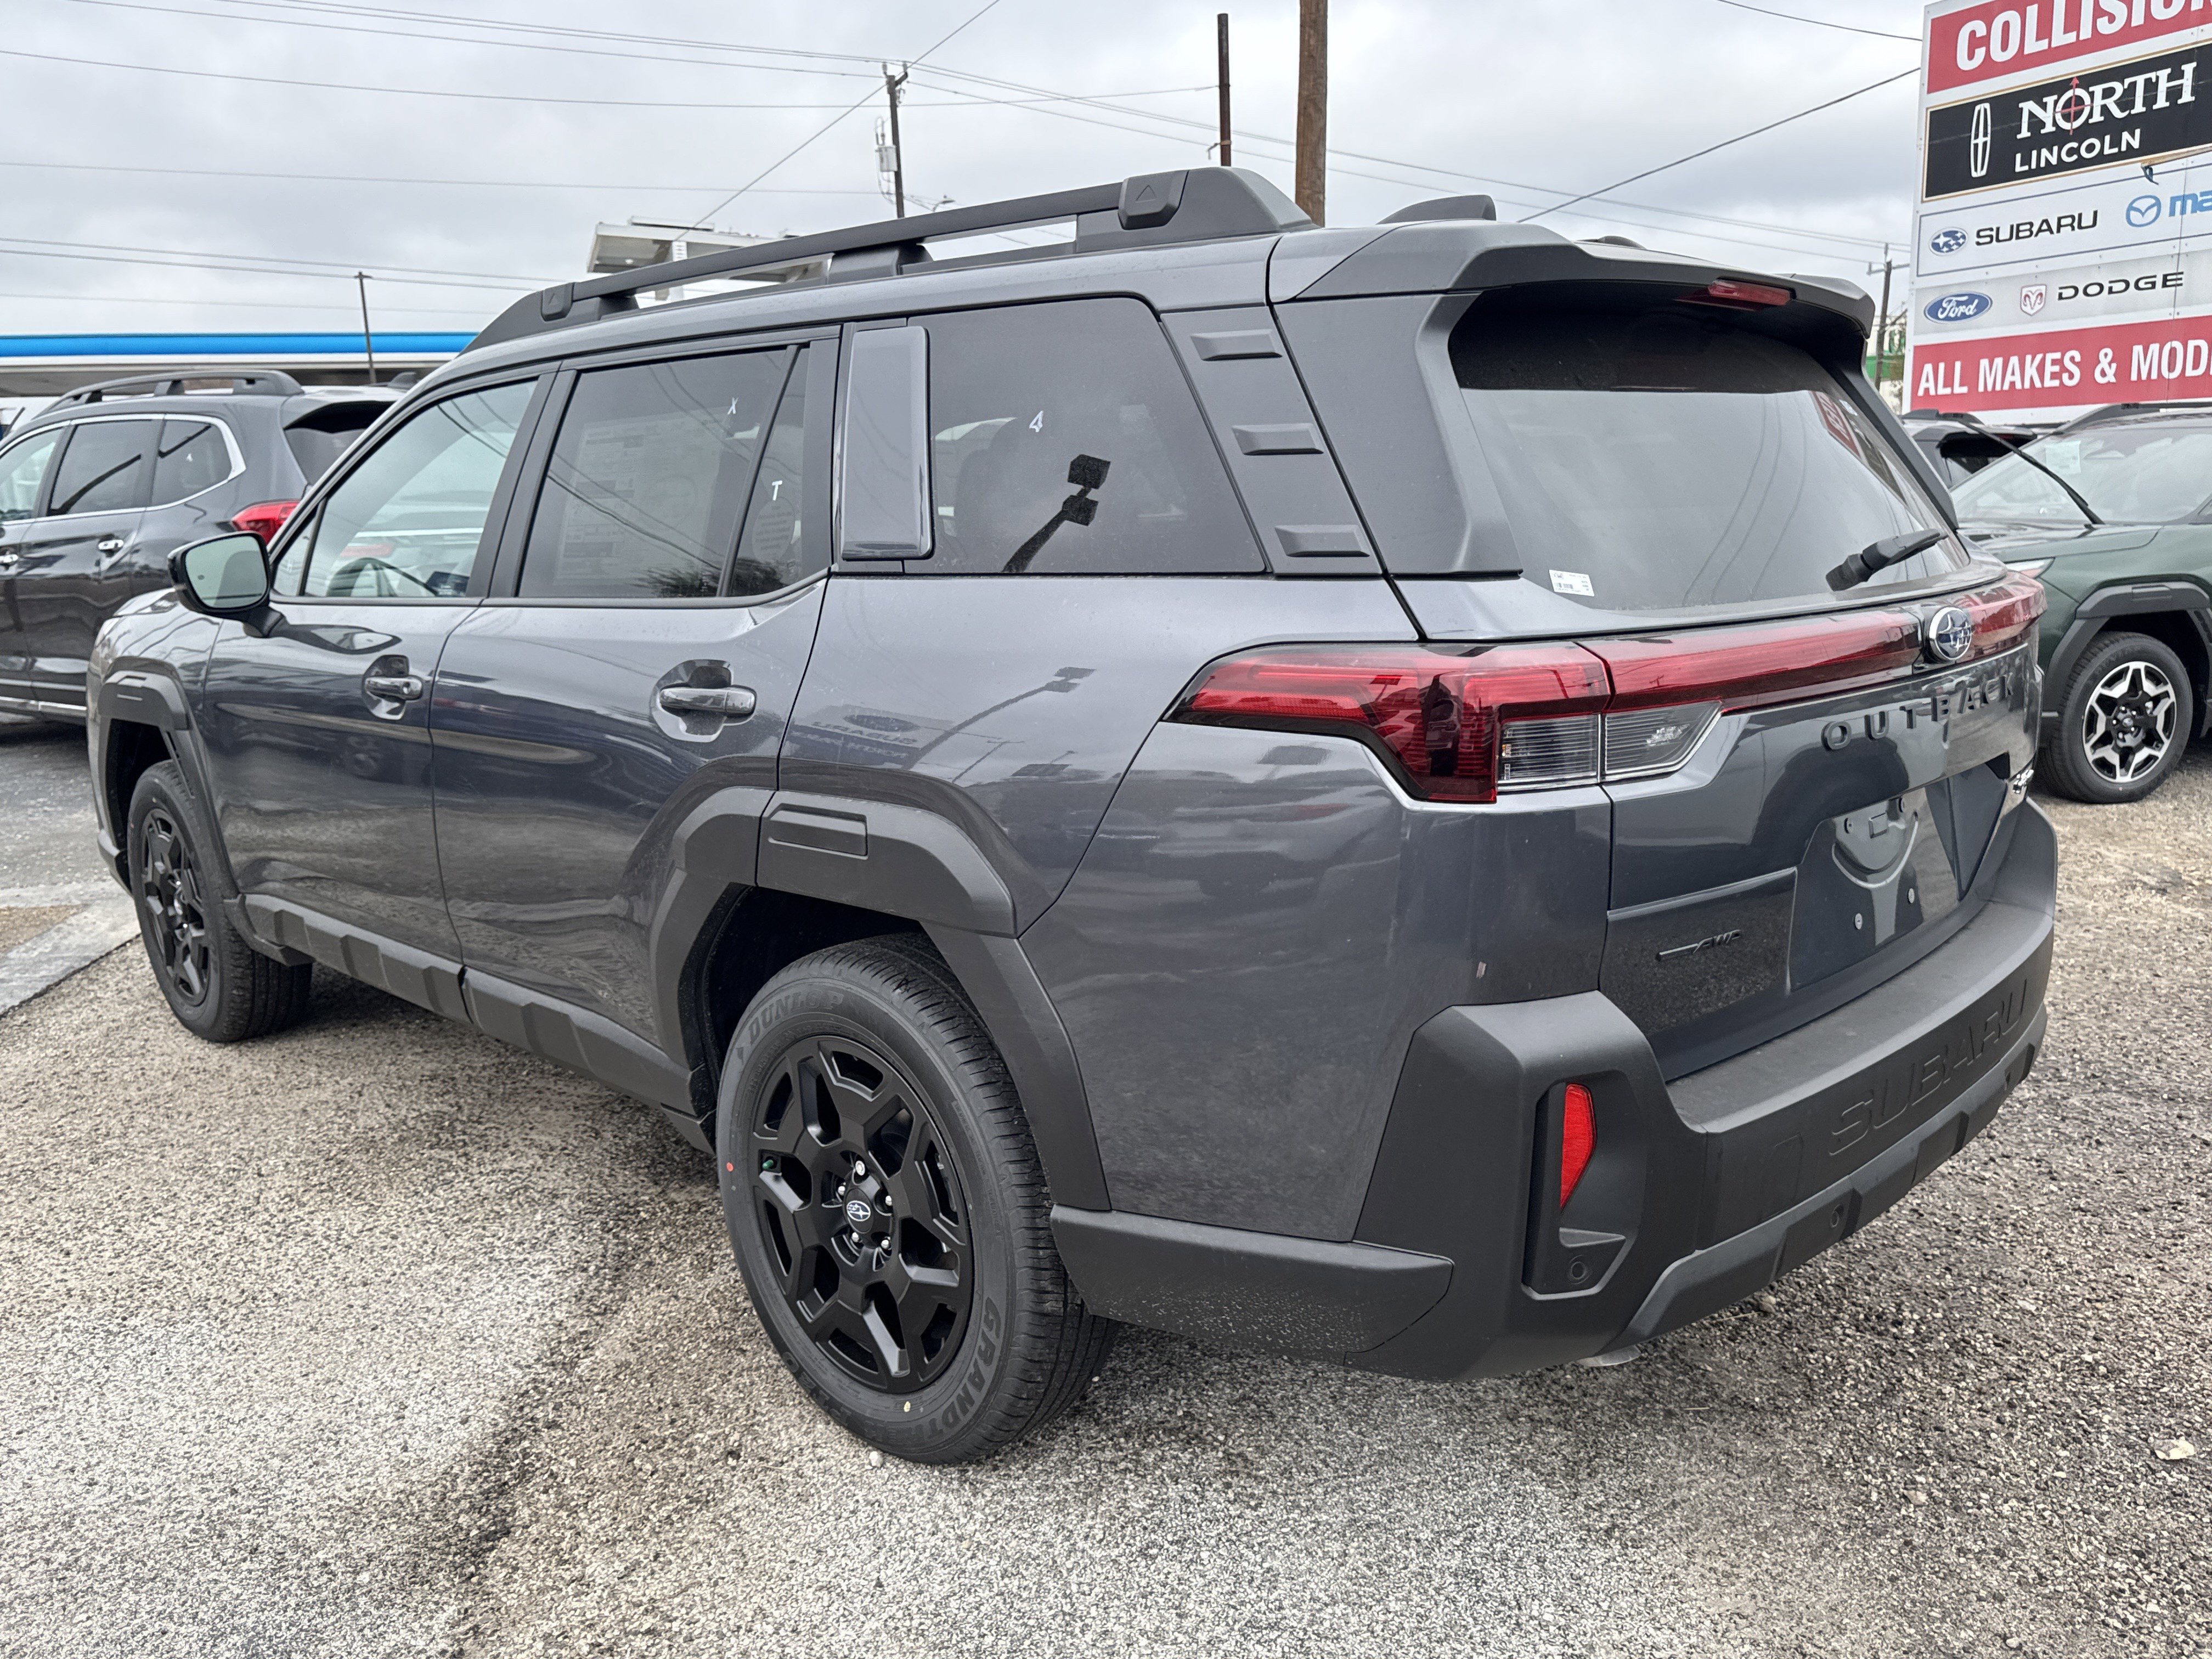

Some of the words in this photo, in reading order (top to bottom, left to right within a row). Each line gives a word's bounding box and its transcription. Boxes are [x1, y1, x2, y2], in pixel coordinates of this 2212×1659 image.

[2016, 61, 2197, 139] NORTH
[2015, 128, 2141, 173] LINCOLN
[1976, 210, 2098, 246] SUBARU
[1938, 295, 1978, 319] Ford
[2058, 272, 2184, 301] DODGE
[1917, 360, 1968, 396] ALL
[1978, 349, 2081, 393] MAKES
[2094, 347, 2117, 385] &
[2130, 339, 2212, 382] MOD
[1029, 410, 1044, 432] 4
[772, 480, 783, 501] T
[1821, 672, 2013, 751] OUTBACK
[748, 989, 845, 1046] DUNLOP
[1829, 979, 2027, 1156] SUBARU
